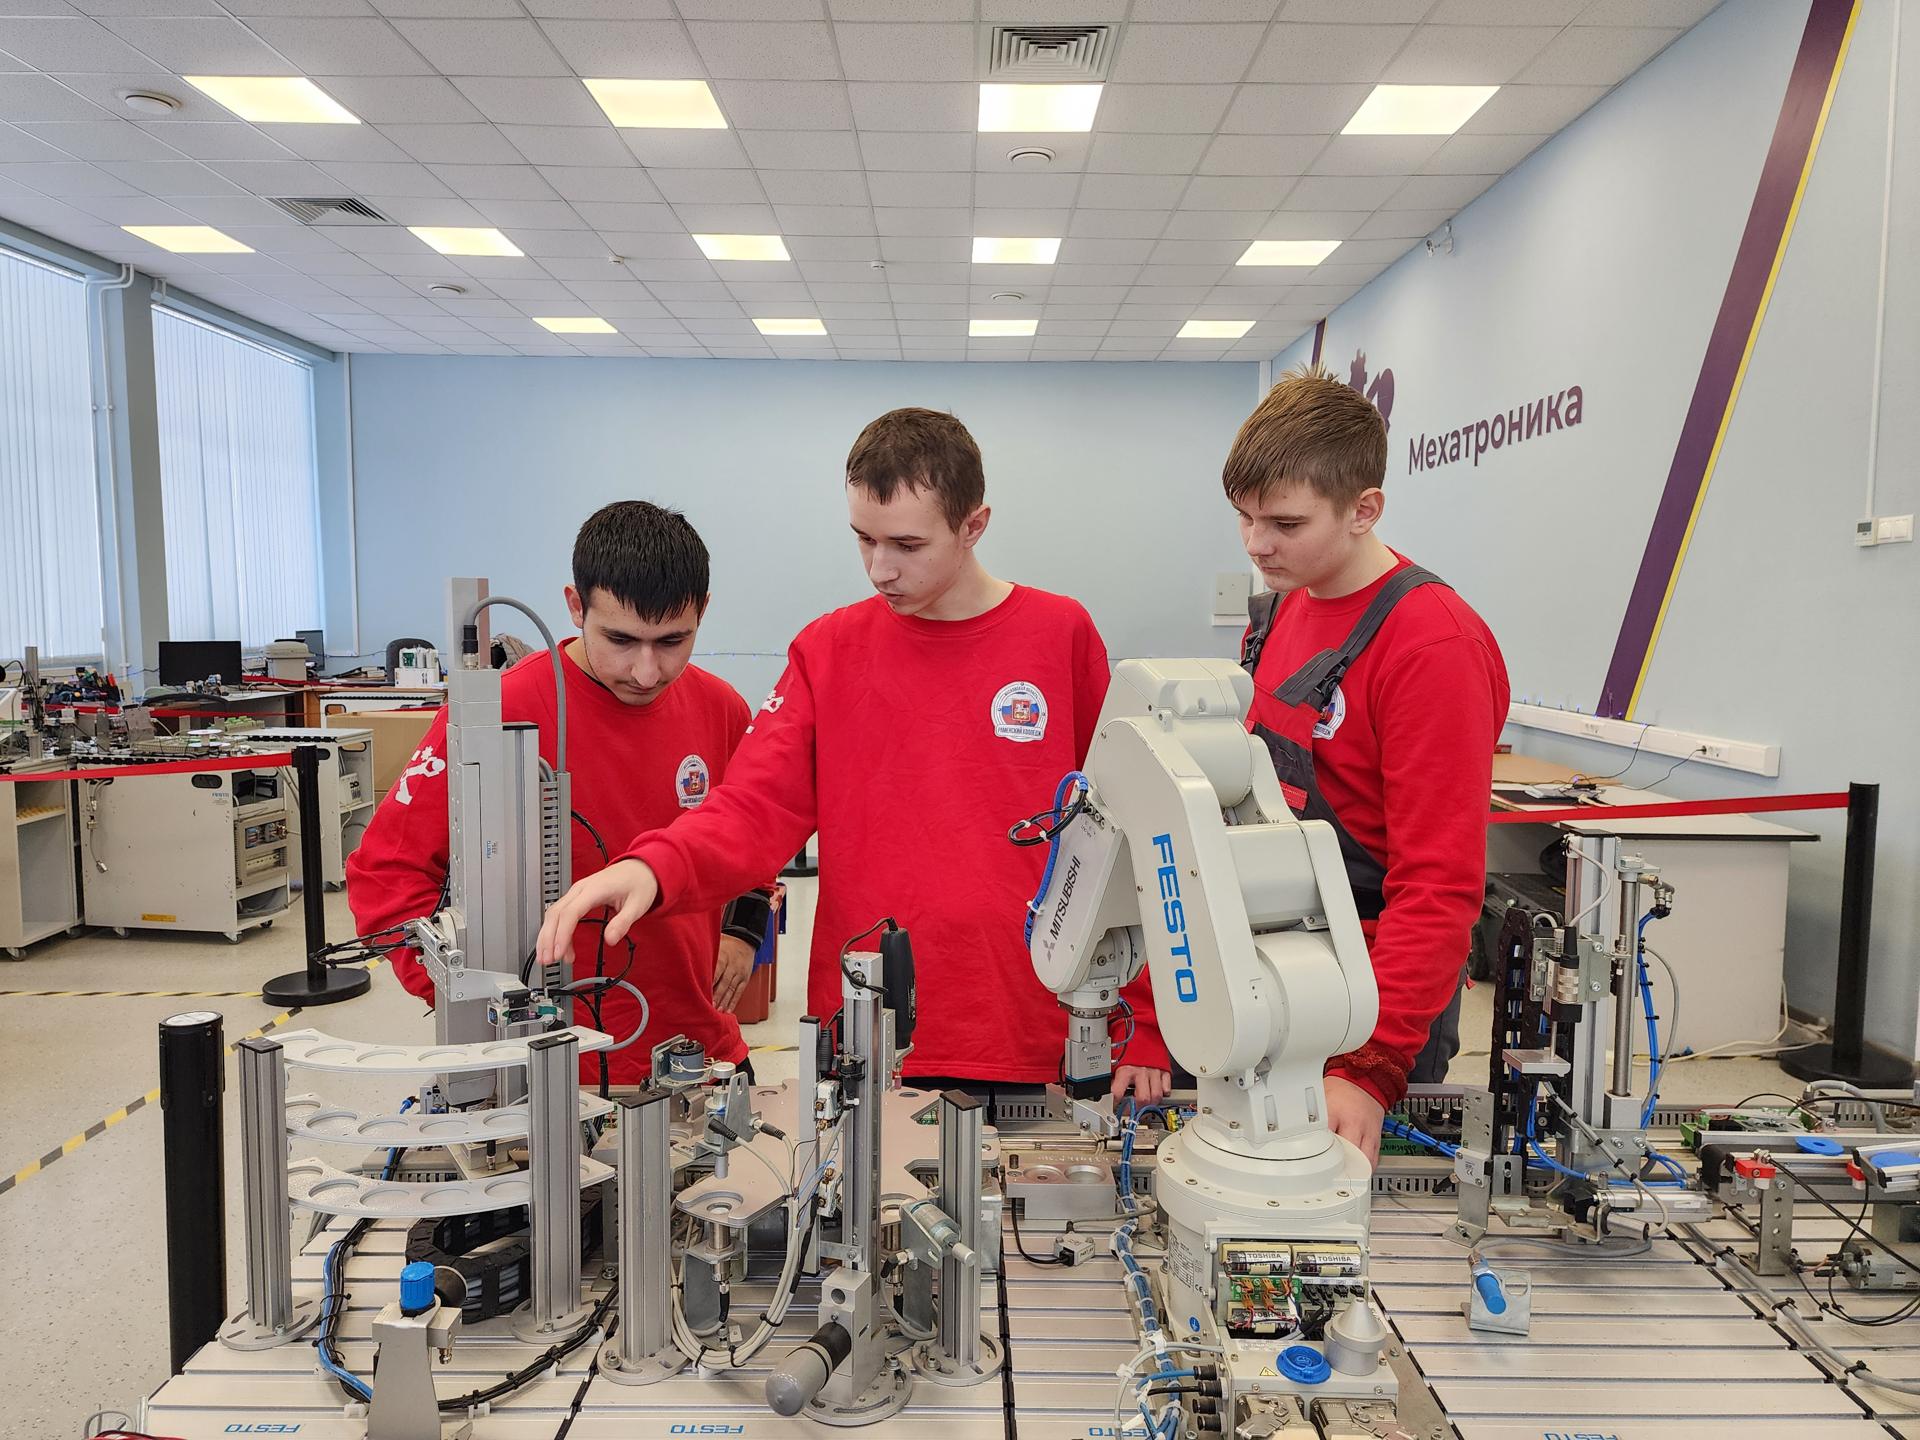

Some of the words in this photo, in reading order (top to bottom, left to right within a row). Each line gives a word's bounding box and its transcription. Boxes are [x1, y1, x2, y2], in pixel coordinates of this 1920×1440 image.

[1408, 385, 1583, 475] Мехатроника
[1049, 855, 1081, 941] MITSUBISHI
[1152, 833, 1198, 1003] FESTO
[224, 1424, 301, 1433] FESTO
[670, 1424, 744, 1434] FESTO
[1088, 1427, 1149, 1437] ESTO
